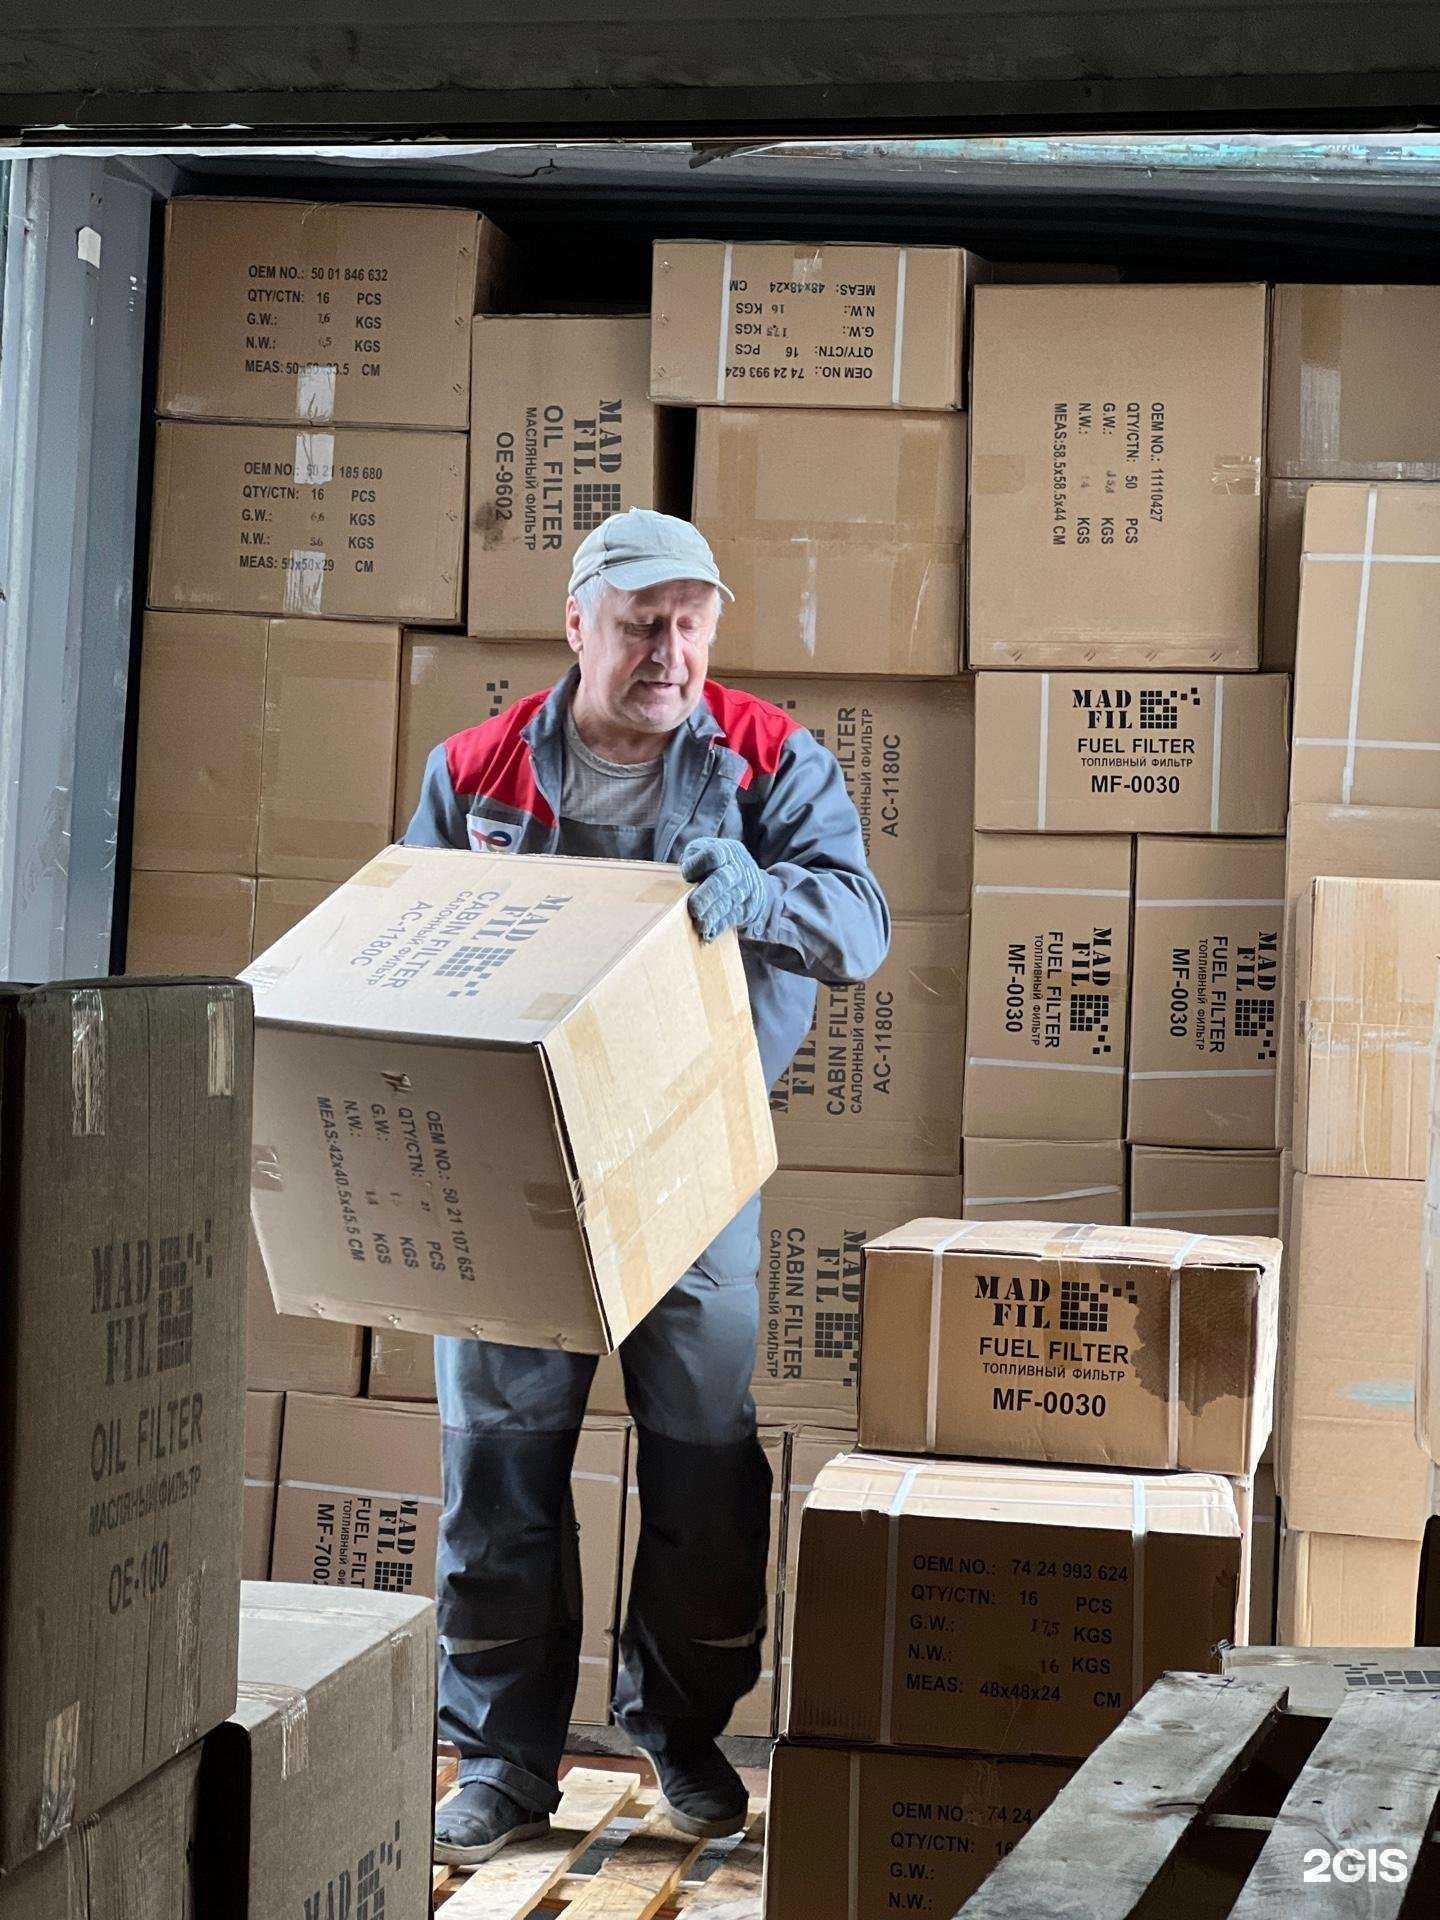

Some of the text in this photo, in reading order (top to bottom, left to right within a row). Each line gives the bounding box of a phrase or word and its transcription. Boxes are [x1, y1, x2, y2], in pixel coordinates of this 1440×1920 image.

[249, 266, 388, 281] OEM NO.: 50 01 846 632
[729, 280, 876, 296] MEAS: 48x48x24 CM
[248, 290, 382, 305] QTY/CTN: 16 PCS
[736, 303, 874, 316] N.W.: 16 KGS
[247, 313, 382, 329] G.W.: KGS
[735, 324, 874, 337] G.W.: KGS
[246, 337, 381, 352] N.W.: KGS
[735, 344, 873, 358] QTY/CTN: 16 PCS
[245, 360, 379, 376] MEAS: CM
[726, 366, 872, 378] OEM NO.: 74 24 993 624
[574, 419, 596, 474] FIL
[600, 399, 622, 473] MAD
[244, 462, 382, 479] OEM 185 680
[496, 432, 514, 520] OE-9602
[525, 407, 538, 550] МАСЛЯНЫЙ ФИЛЬТР
[543, 405, 563, 550] OIL FILTER
[1077, 403, 1091, 544] N.W.: KGS
[1101, 403, 1116, 544] G.W.: KGS
[1126, 403, 1140, 543] QTY/CTN: 50 PCS
[1150, 403, 1164, 522] OEM NO.: 11110427
[243, 486, 376, 502] QTY/CTN: 16 PCS
[241, 532, 374, 549] N.W.: KGS
[242, 509, 375, 526] G.W.: KGS
[1053, 526, 1066, 545] CM
[240, 556, 373, 572] MEAS: CM
[1072, 690, 1132, 707] MAD
[1088, 711, 1132, 728] FIL
[861, 709, 873, 767] ФИЛЬТР
[1078, 739, 1195, 753] FUEL FILTER
[1081, 756, 1193, 767] ТОПЛИВНЫЙ ФИЛЬТР
[1092, 775, 1179, 793] MF-0030
[881, 735, 900, 837] AC-1180C
[351, 900, 432, 966] AC-1180C
[368, 891, 473, 985] САЛОННЫЙ ФИЛЬТР
[382, 891, 500, 988] CABIN FILTER
[471, 905, 530, 940] FIL
[505, 895, 573, 941] MAD
[1071, 941, 1090, 986] FIL
[1093, 928, 1112, 986] MAD
[1236, 947, 1256, 991] FIL
[1257, 931, 1277, 991] MAD
[1006, 944, 1026, 1032] MF-0030
[1032, 935, 1044, 1046] ТОПЛИВНЫЙ ФИЛЬТР
[1045, 931, 1063, 1049] FUEL FILTER
[1171, 948, 1190, 1037] MF-0030
[1196, 939, 1208, 1050] ТОПЛИВНЫЙ ФИЛЬТР
[1209, 936, 1228, 1053] FUEL FILTER
[873, 991, 893, 1094] AC-1180C
[827, 1046, 846, 1115] CABIN
[851, 1029, 864, 1114] САЛОННЫЙ
[344, 1101, 391, 1264] N.W.: KGS
[372, 1104, 419, 1269] G.W.: KGS
[399, 1107, 446, 1272] QTY/CTN: PCS
[426, 1110, 475, 1281] OEM 21 107 652
[349, 1239, 365, 1261] CM
[842, 1229, 866, 1302] MAD
[91, 1240, 151, 1313] MAD
[817, 1248, 840, 1303] FIL
[975, 1276, 1050, 1302] MAD
[767, 1229, 781, 1377] САЛОННЫЙ ФИЛЬТР
[783, 1228, 805, 1379] CABIN FILTER
[993, 1303, 1051, 1328] FIL
[106, 1312, 150, 1385] FIL
[980, 1337, 1129, 1364] FUEL FILTER
[983, 1362, 1125, 1381] ТОПЛИВНЫЙ ФИЛЬТР
[992, 1388, 1106, 1417] MF-0030
[91, 1393, 202, 1481] OIL FILTER
[339, 1500, 352, 1565] ТОПЛИВНЫЙ
[353, 1498, 372, 1544] FUEL
[377, 1510, 397, 1554] FIL
[398, 1501, 418, 1554] MAD
[109, 1541, 168, 1616] OE-100
[914, 1555, 1128, 1581] OEM NO.: 74 24 993 624
[912, 1585, 1112, 1614] QTY/CTN: 16 PCS
[910, 1615, 1112, 1644] G.W.: KGS
[908, 1644, 1110, 1674] N.W.: 16 KGS
[907, 1673, 1121, 1708] MEAS: 48x48x24 CM
[893, 1802, 932, 1819] OEM
[891, 1832, 974, 1853] QTY/CTN:
[890, 1862, 934, 1880] G.W.:
[888, 1892, 932, 1910] N.W.:
